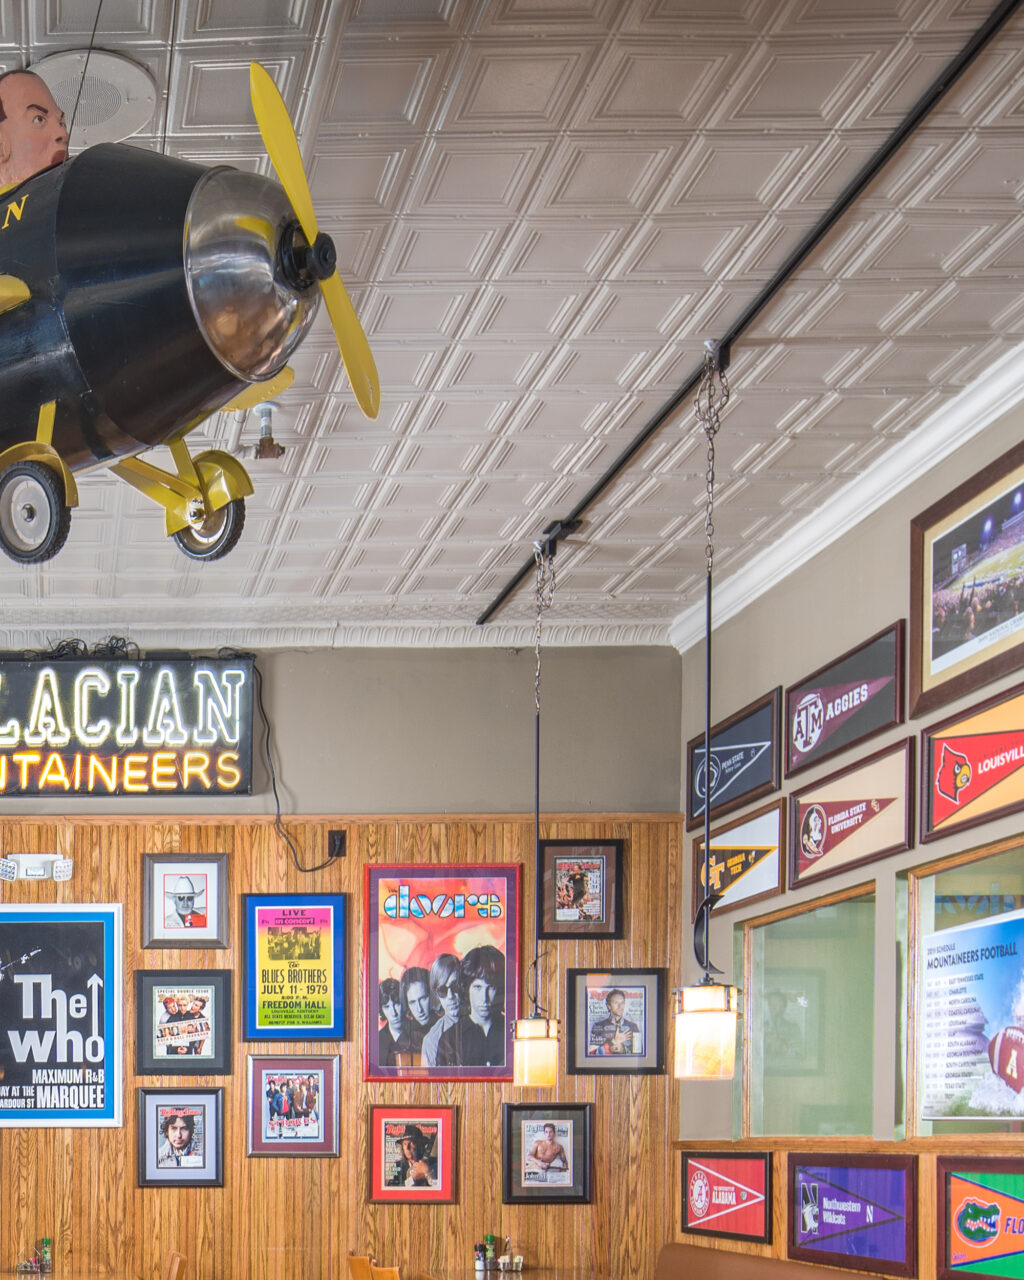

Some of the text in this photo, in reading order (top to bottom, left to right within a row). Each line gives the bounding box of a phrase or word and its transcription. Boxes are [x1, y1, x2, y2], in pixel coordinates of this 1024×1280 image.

[825, 683, 868, 721] AGGIES
[828, 810, 849, 825] FLORIDA
[850, 802, 867, 816] STATE
[831, 814, 863, 834] UNIVERSITY
[384, 885, 502, 918] doors
[927, 942, 1018, 970] MOUNTAINEERS FOOTBALL
[262, 969, 327, 983] BLUES BROTHERS
[14, 974, 87, 1019] The
[261, 985, 284, 994] JULY
[290, 985, 297, 994] 11
[306, 985, 328, 994] 1979
[1006, 1048, 1017, 1079] A
[32, 1069, 104, 1084] MAXIMUM R&B
[11, 1085, 20, 1096] AT
[22, 1085, 35, 1096] THE
[36, 1085, 104, 1109] MARQUEE
[27, 1099, 35, 1109] ST
[712, 1191, 736, 1205] ALABAMA
[823, 1197, 861, 1213] Northwestern
[823, 1211, 846, 1225] Wildcats
